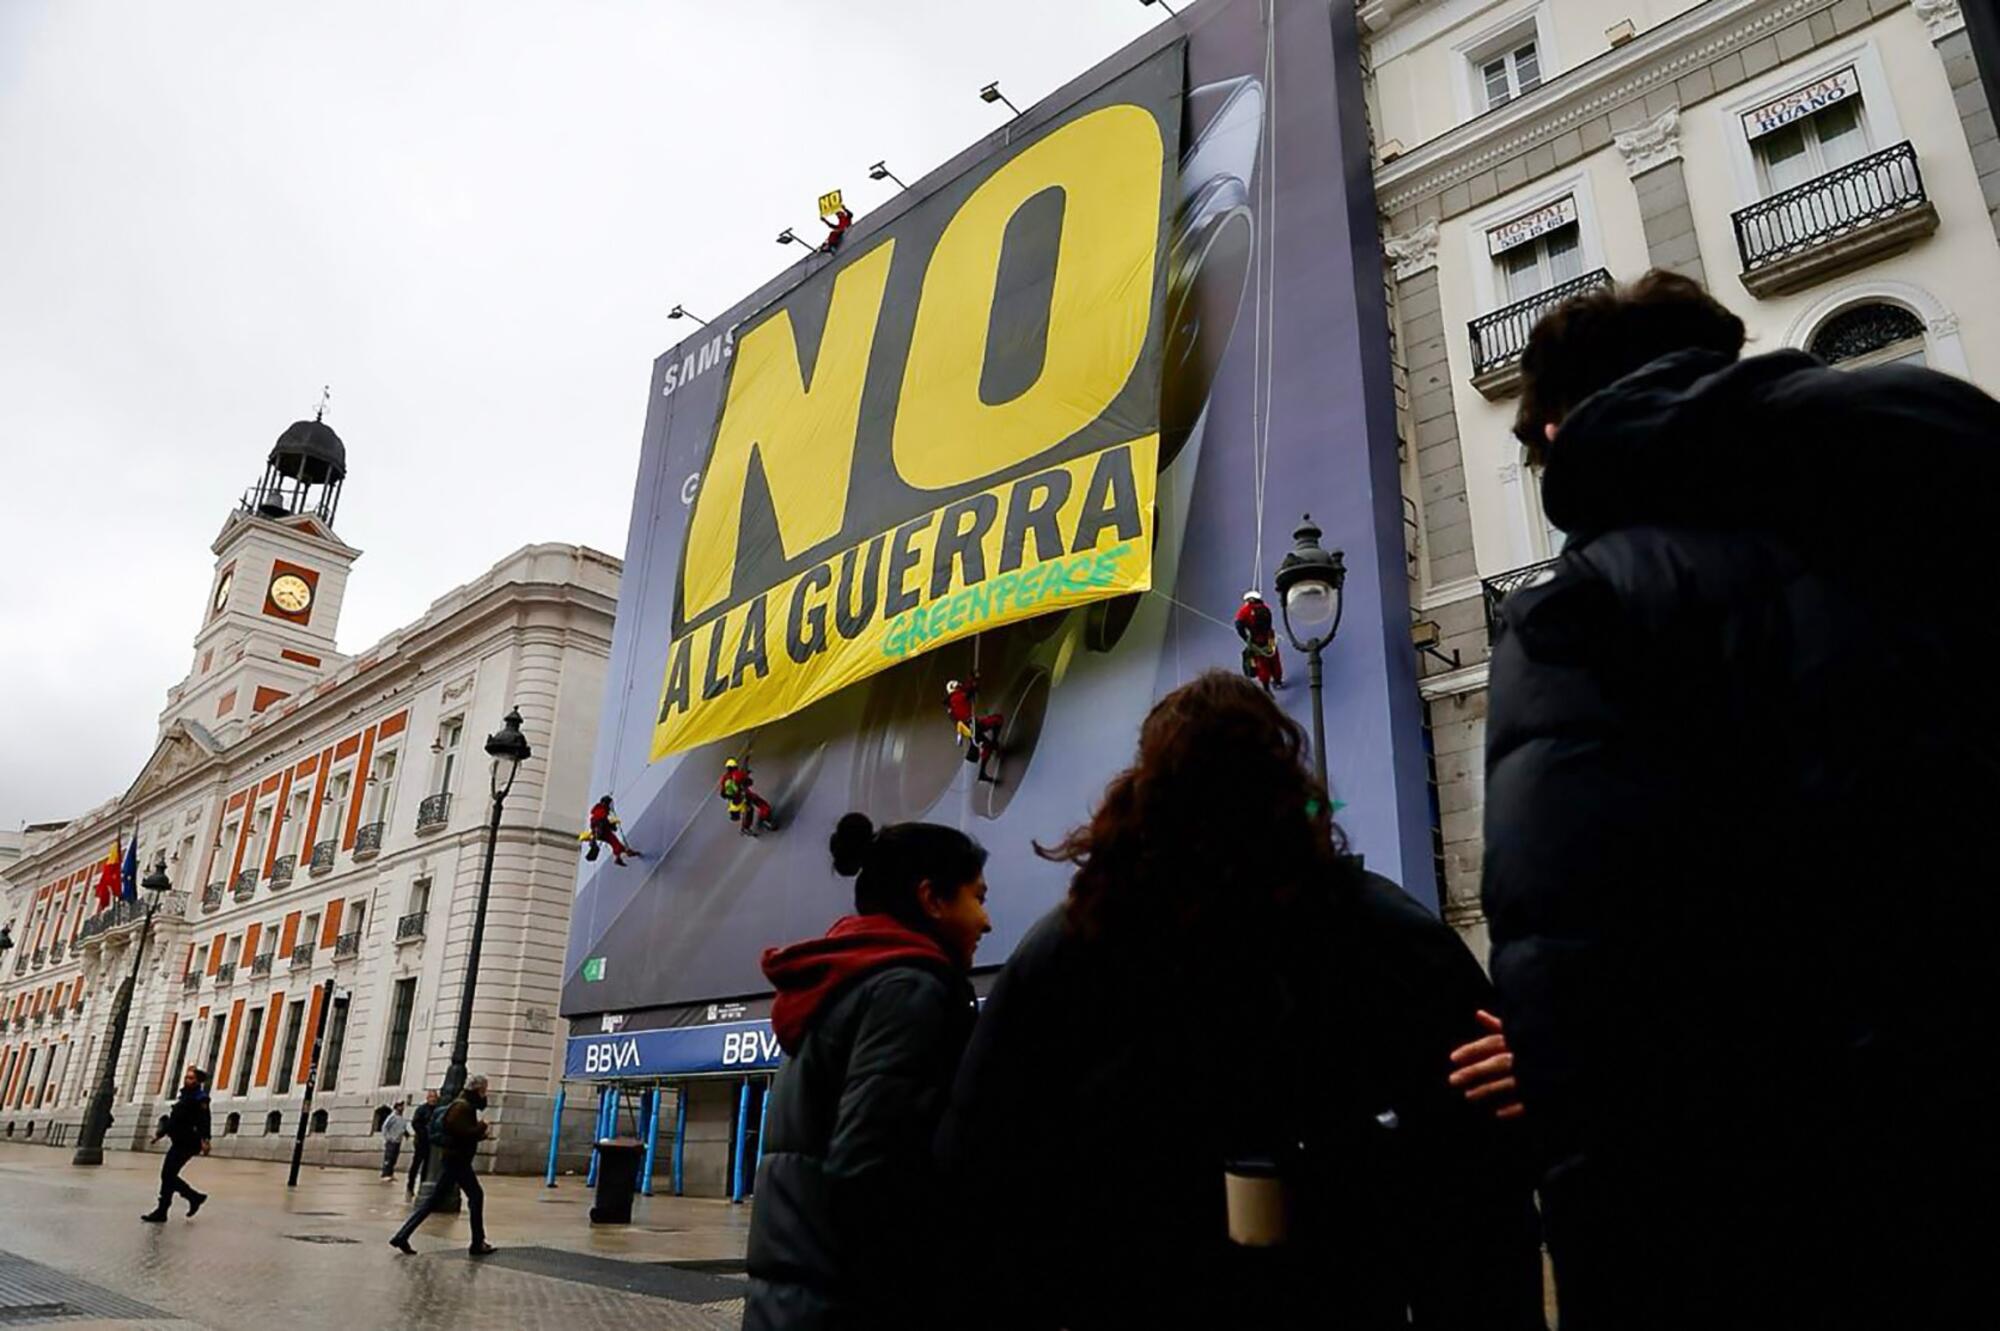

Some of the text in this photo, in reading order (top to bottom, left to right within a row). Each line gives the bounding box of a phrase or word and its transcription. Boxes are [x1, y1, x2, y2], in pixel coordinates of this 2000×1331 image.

[1753, 78, 1848, 122] HOSTAL
[1760, 87, 1846, 132] RUANO
[820, 192, 840, 211] NO
[1494, 205, 1568, 240] HOSTAL
[683, 104, 1163, 624] NO
[658, 445, 1142, 724] A LA GUERRA
[880, 544, 1132, 657] GREENPEACE
[585, 1037, 641, 1073] BBVA
